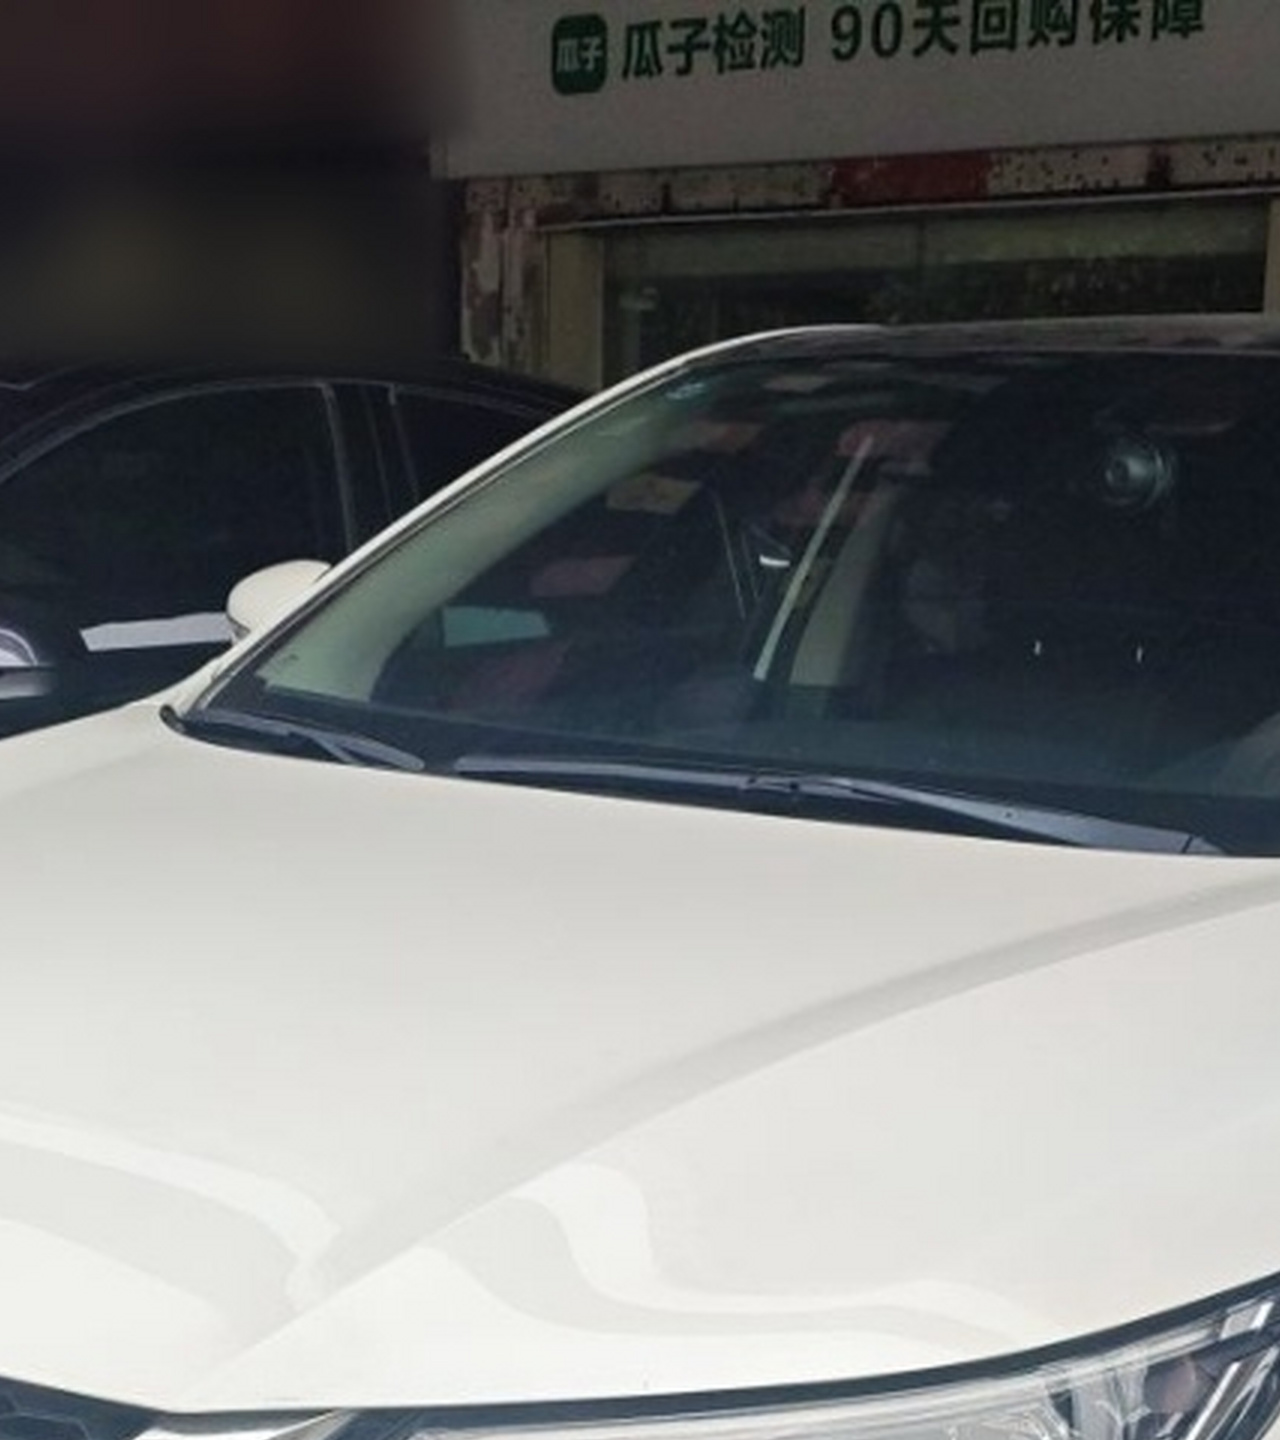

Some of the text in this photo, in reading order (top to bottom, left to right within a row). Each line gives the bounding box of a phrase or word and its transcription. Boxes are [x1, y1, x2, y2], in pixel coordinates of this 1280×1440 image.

[556, 36, 604, 73] 瓜子
[622, 6, 807, 80] 瓜子检测
